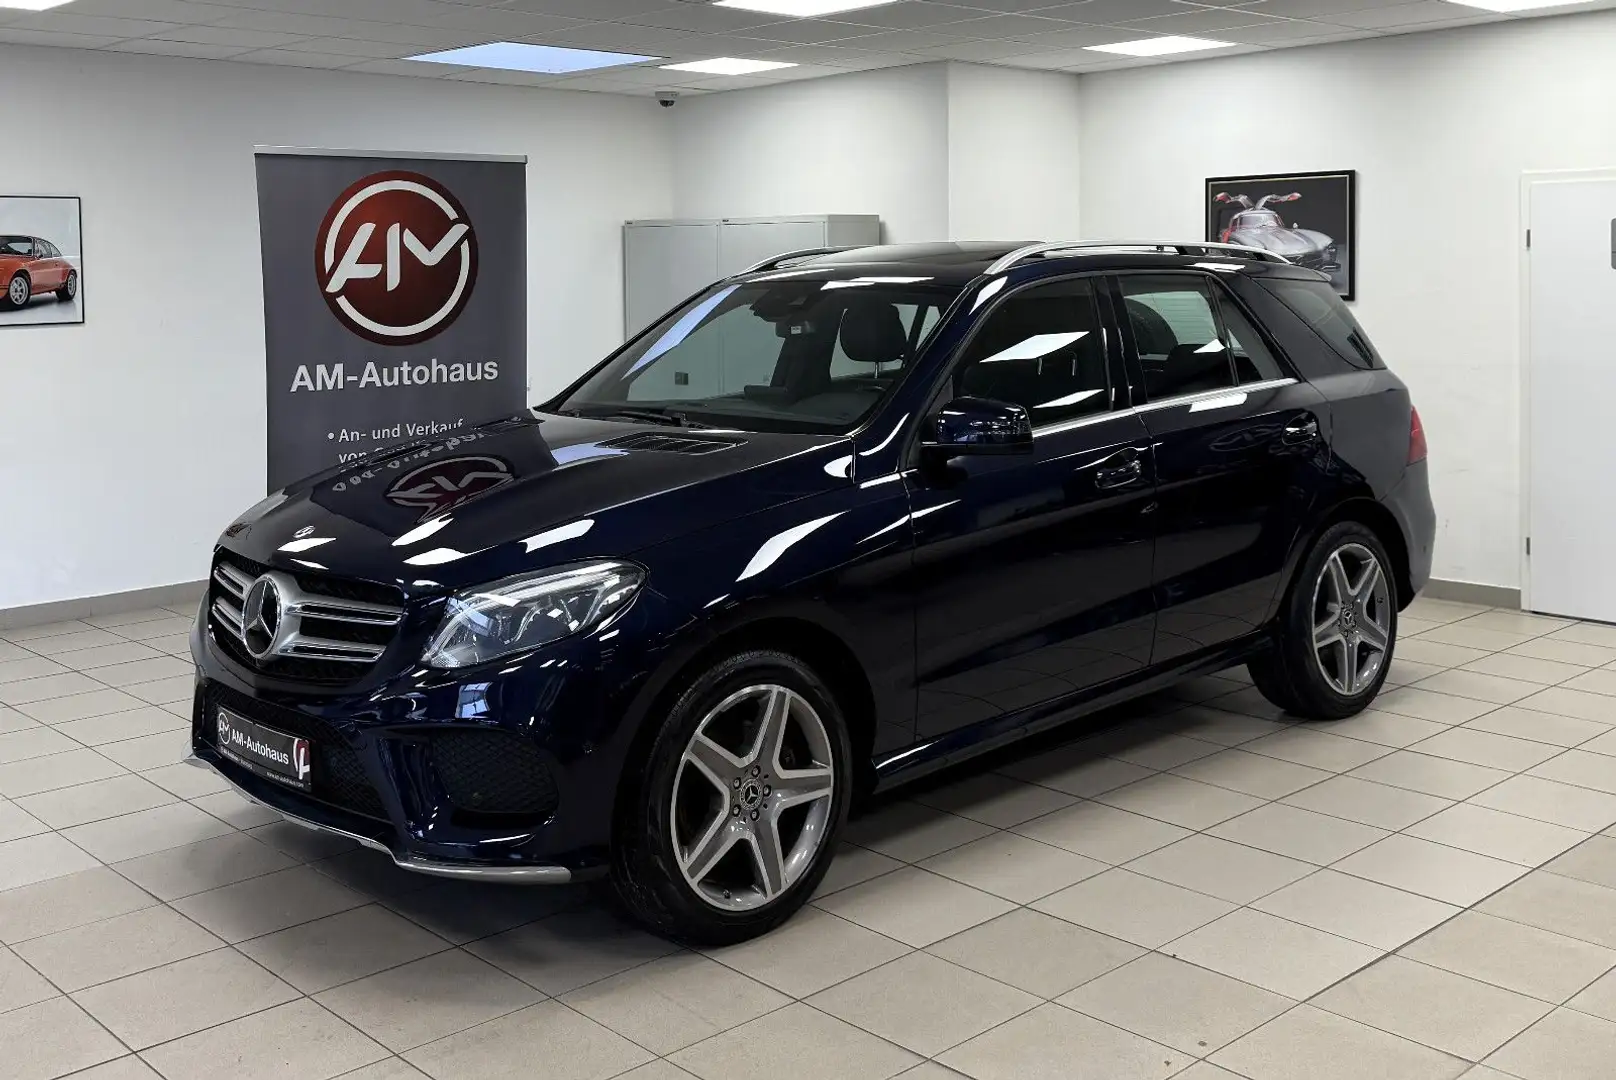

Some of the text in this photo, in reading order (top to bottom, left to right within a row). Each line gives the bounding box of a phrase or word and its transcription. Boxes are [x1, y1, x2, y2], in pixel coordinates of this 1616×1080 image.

[290, 359, 499, 393] AM-Autohaus
[338, 428, 367, 443] An-
[372, 423, 400, 440] und
[232, 728, 290, 765] AM-Autohaus
